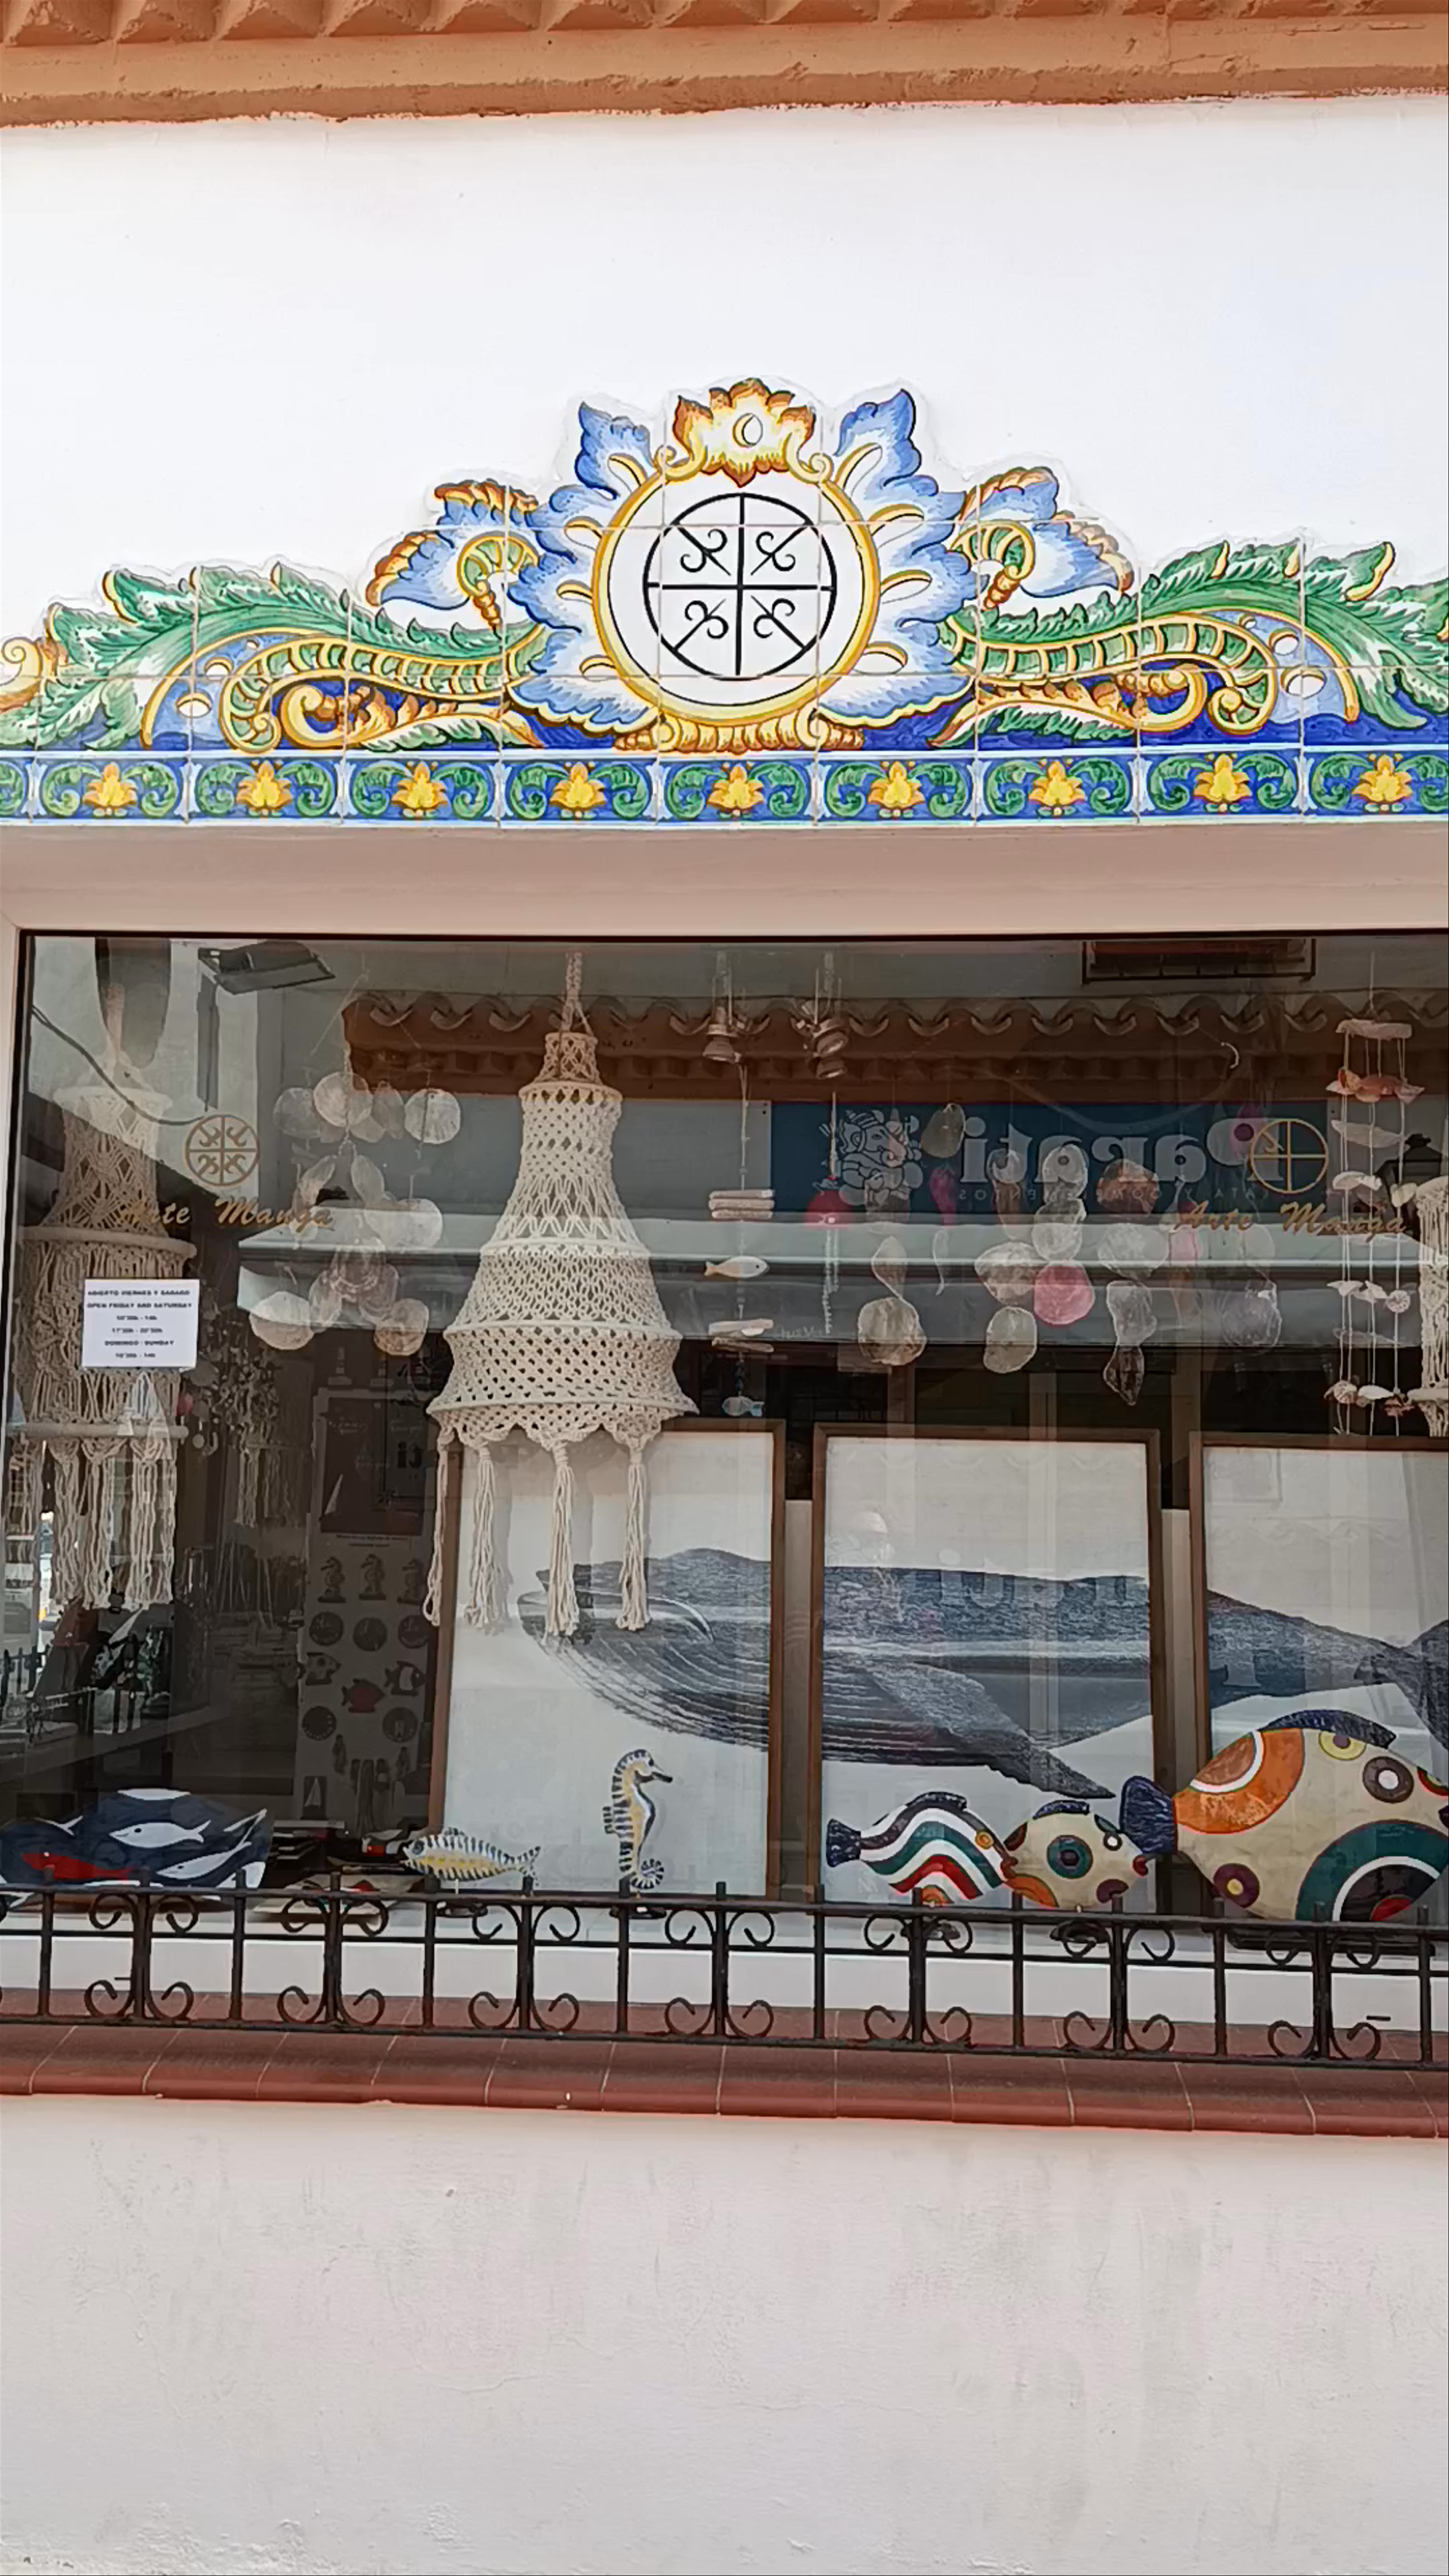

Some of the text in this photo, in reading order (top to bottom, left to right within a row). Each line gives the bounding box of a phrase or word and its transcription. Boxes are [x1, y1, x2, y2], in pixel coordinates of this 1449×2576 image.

[215, 1195, 334, 1233] Manga
[1174, 1200, 1406, 1243] Arte Manga
